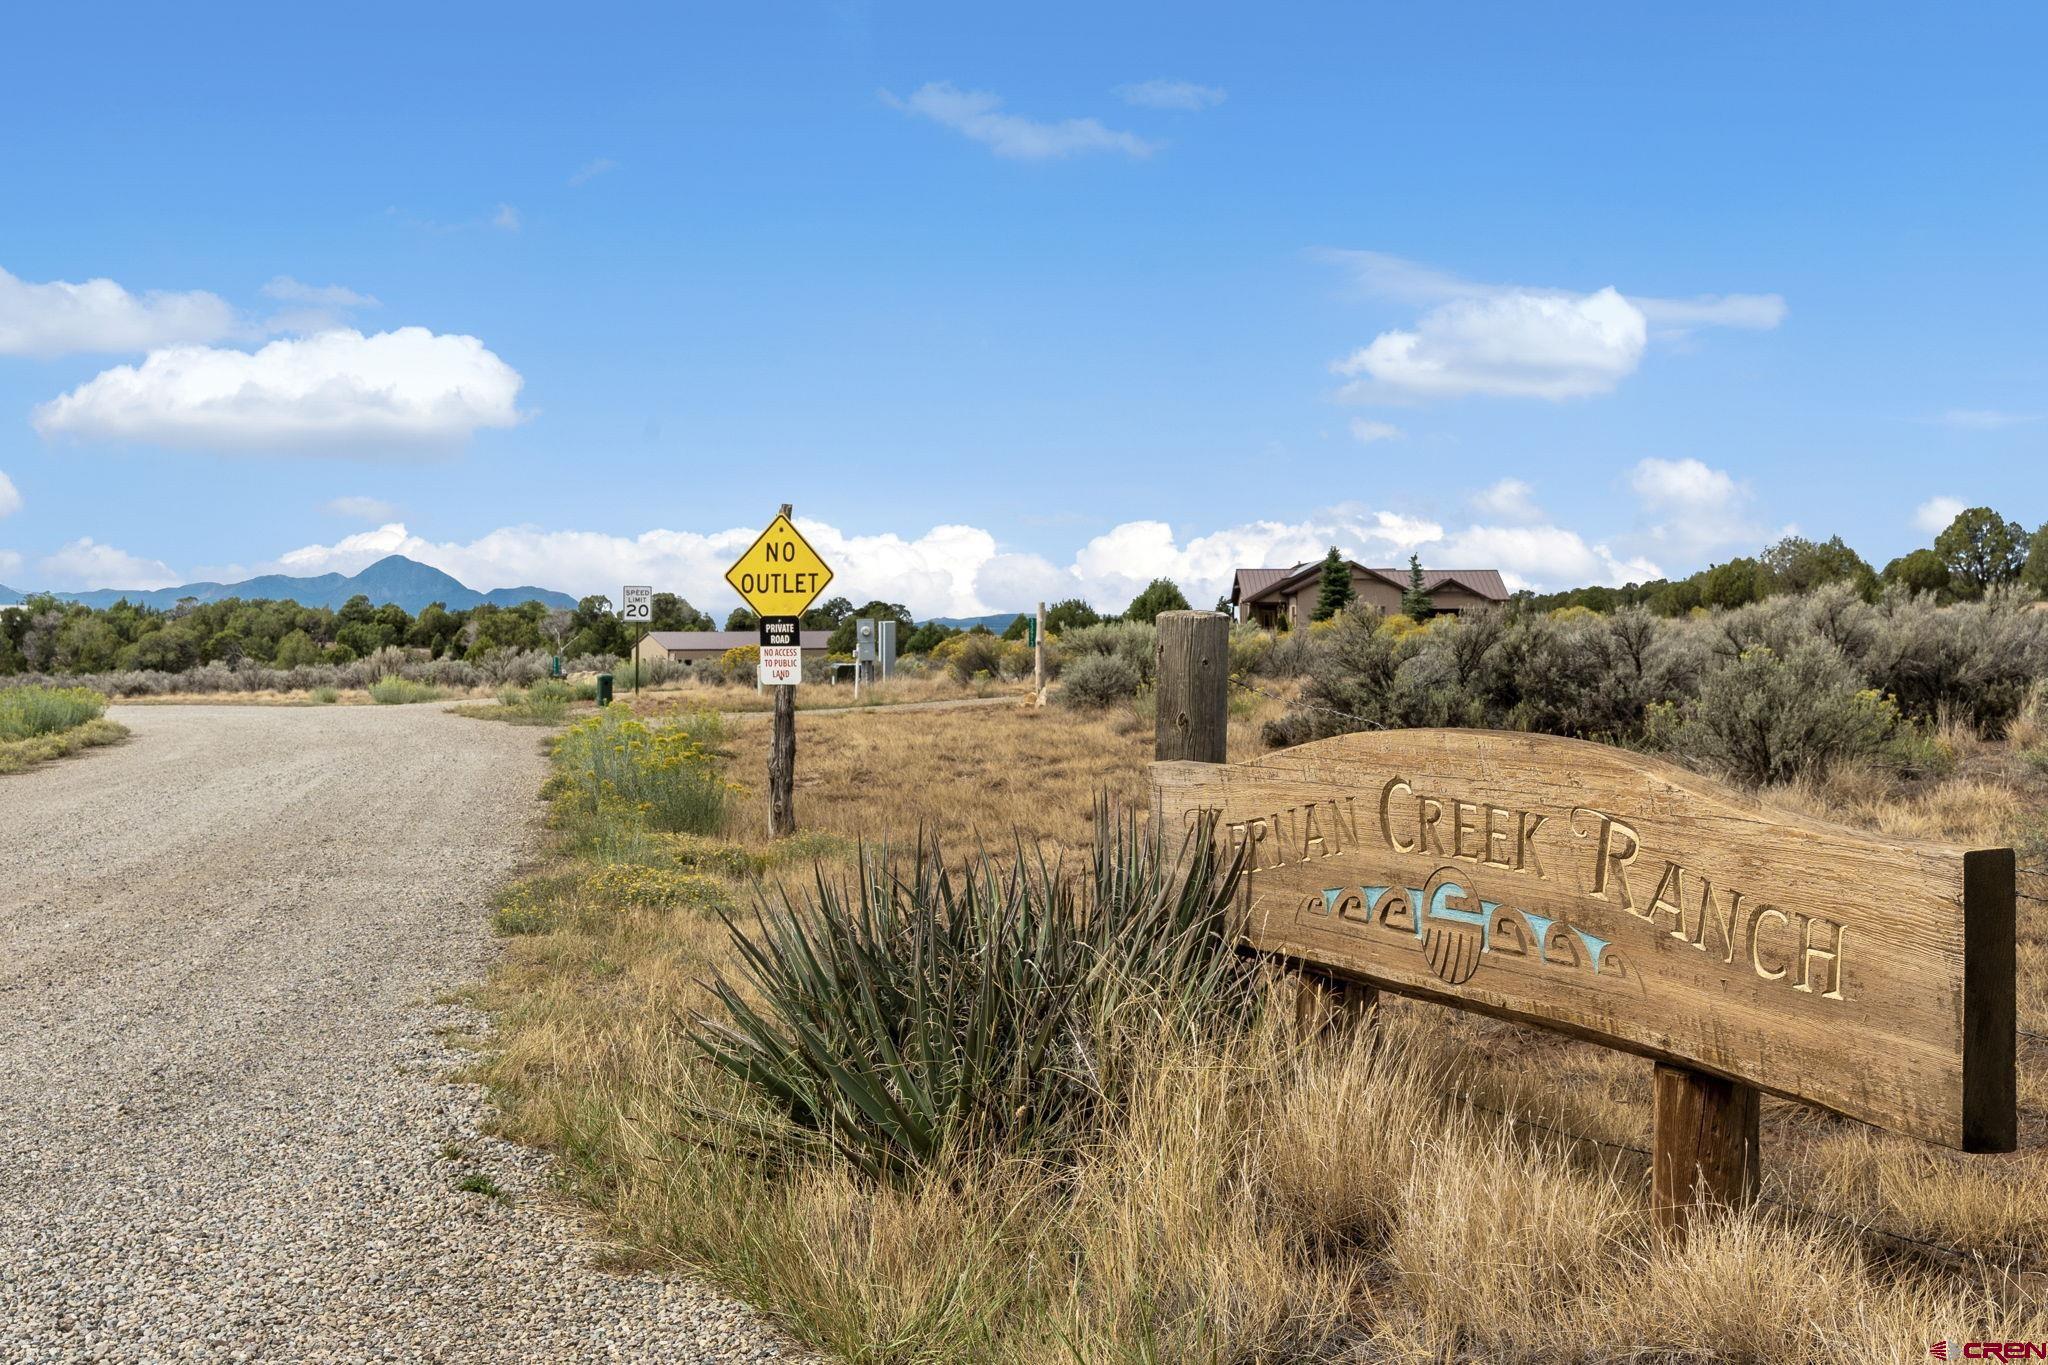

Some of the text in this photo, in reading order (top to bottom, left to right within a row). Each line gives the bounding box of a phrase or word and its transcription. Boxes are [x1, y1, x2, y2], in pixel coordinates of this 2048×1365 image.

[766, 542, 796, 562] NO
[741, 573, 819, 594] OUTLET
[626, 604, 649, 617] 20
[765, 623, 795, 634] PRIVATE
[770, 635, 790, 644] ROAD
[765, 659, 798, 667] TO PUBLIC
[1379, 775, 1549, 880] CREEK
[1569, 806, 1848, 1001] RANCH
